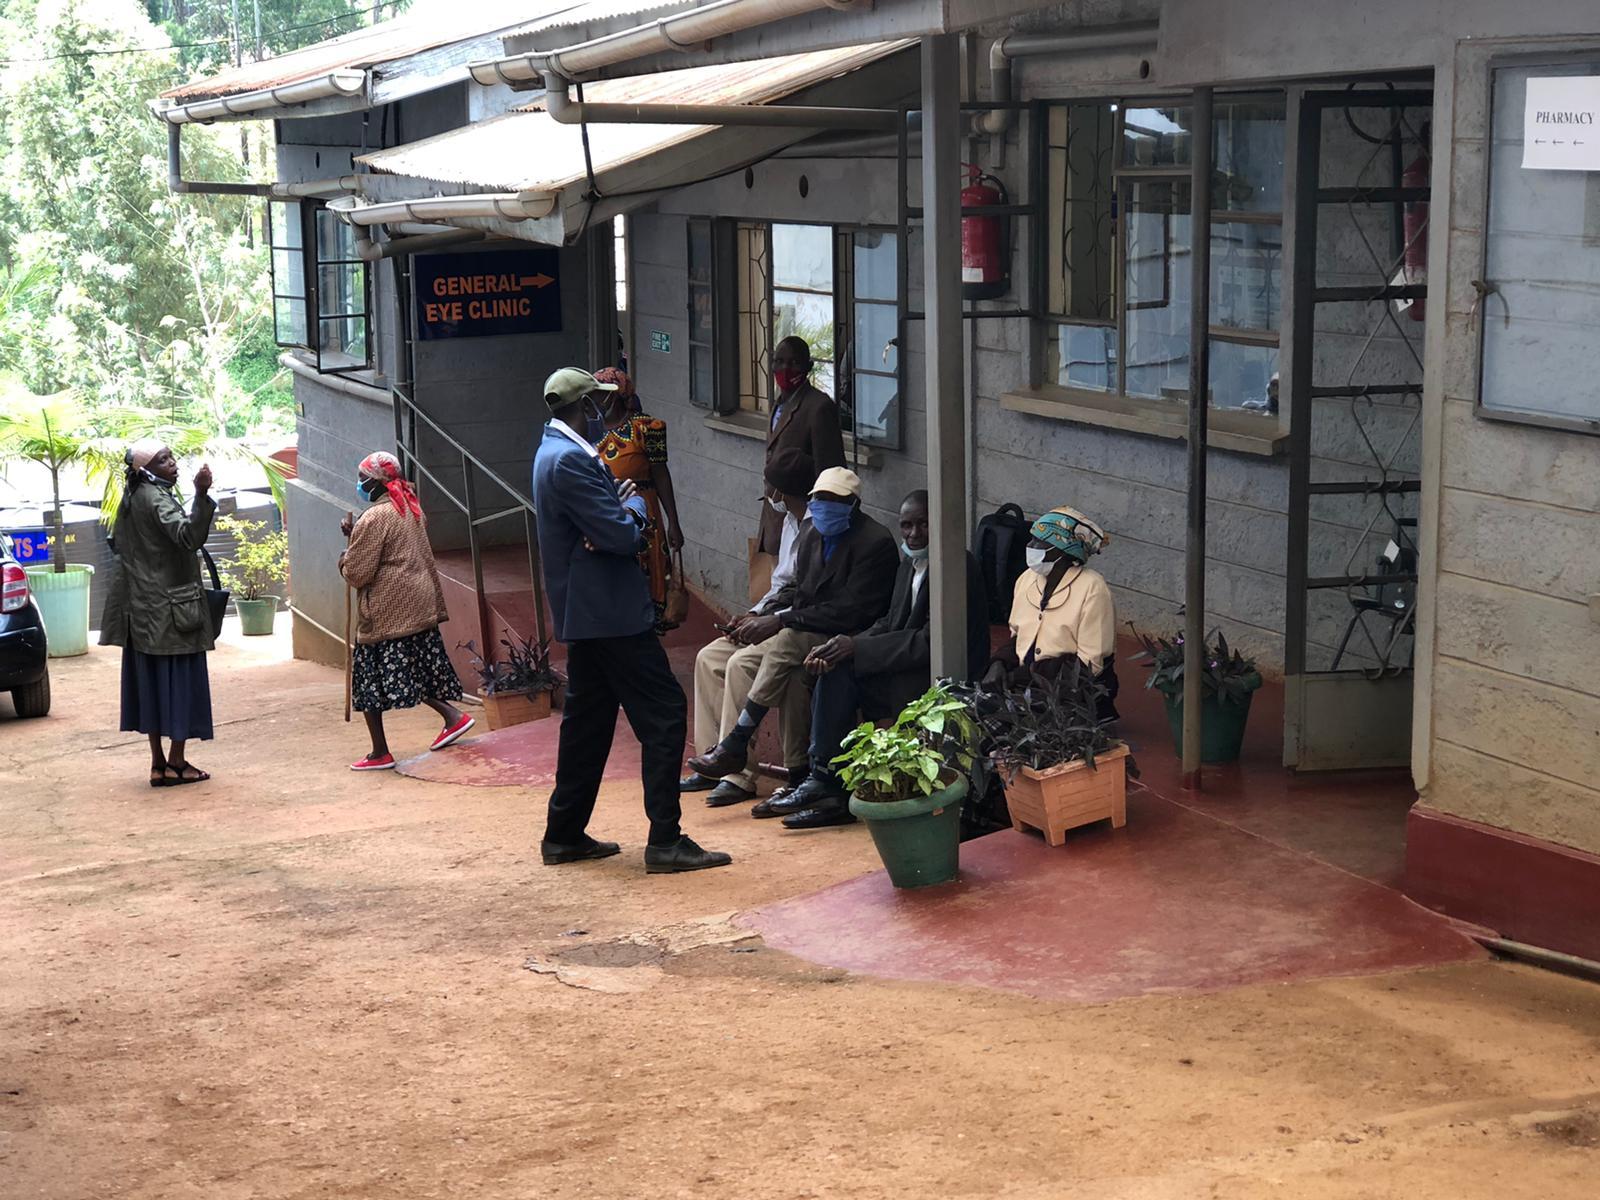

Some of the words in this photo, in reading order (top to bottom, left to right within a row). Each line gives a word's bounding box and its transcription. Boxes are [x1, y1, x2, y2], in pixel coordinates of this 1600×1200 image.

[1535, 111, 1594, 125] PHARMACY
[433, 274, 521, 295] GENERAL
[426, 302, 463, 322] EYE
[469, 298, 531, 319] CLINIC
